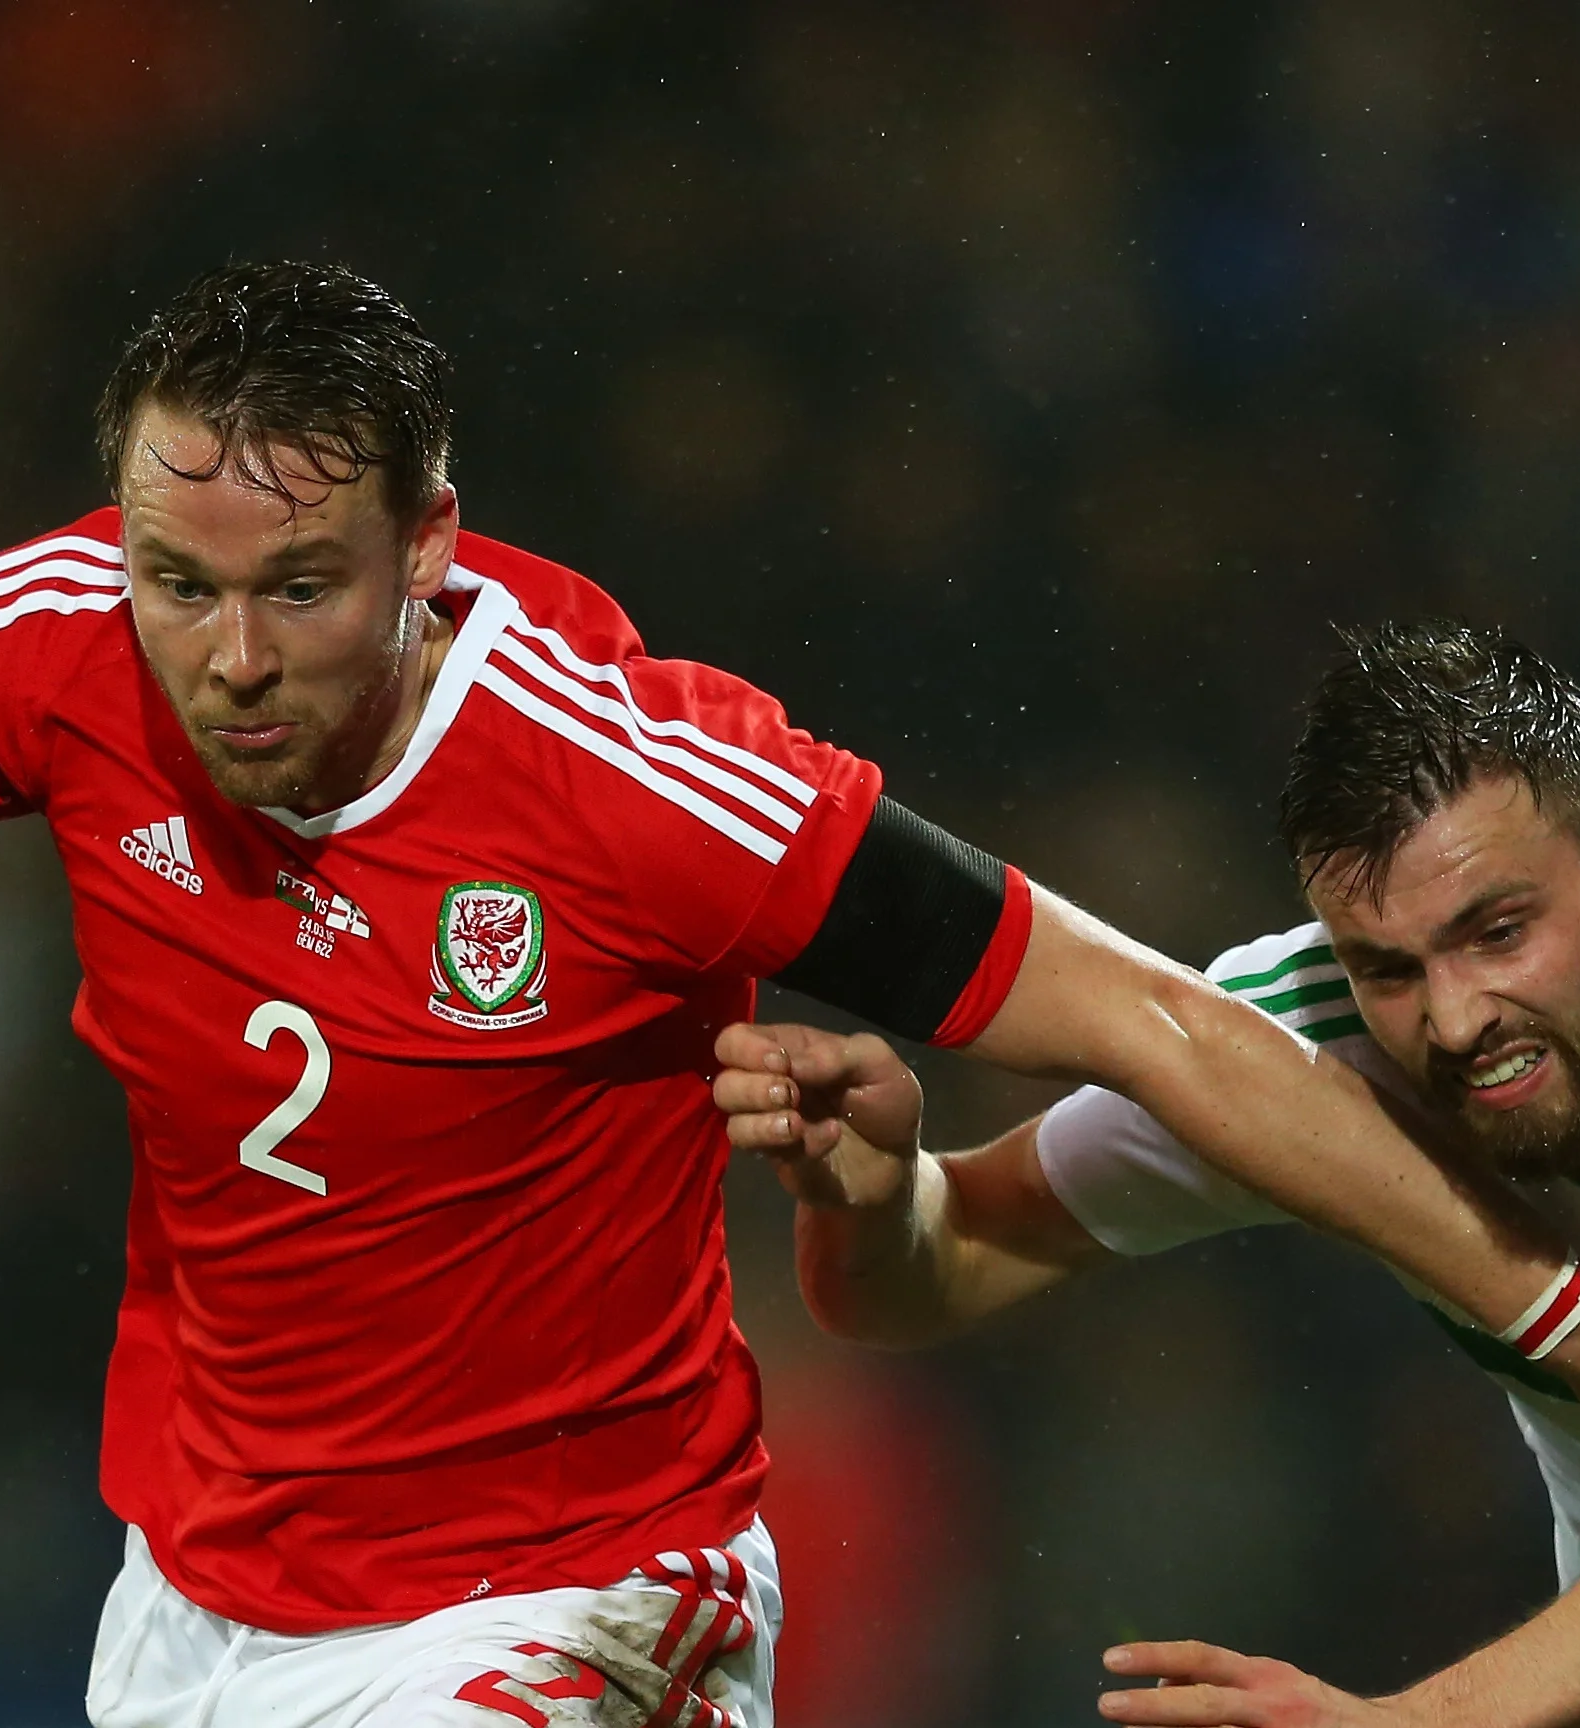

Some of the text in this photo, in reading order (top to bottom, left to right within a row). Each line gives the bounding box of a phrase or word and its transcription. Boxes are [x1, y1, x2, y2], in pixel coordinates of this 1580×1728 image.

[120, 836, 203, 895] adidas
[315, 896, 329, 915] VS
[299, 915, 335, 943] 24.03.16
[315, 940, 333, 959] 622
[239, 1000, 331, 1197] 2
